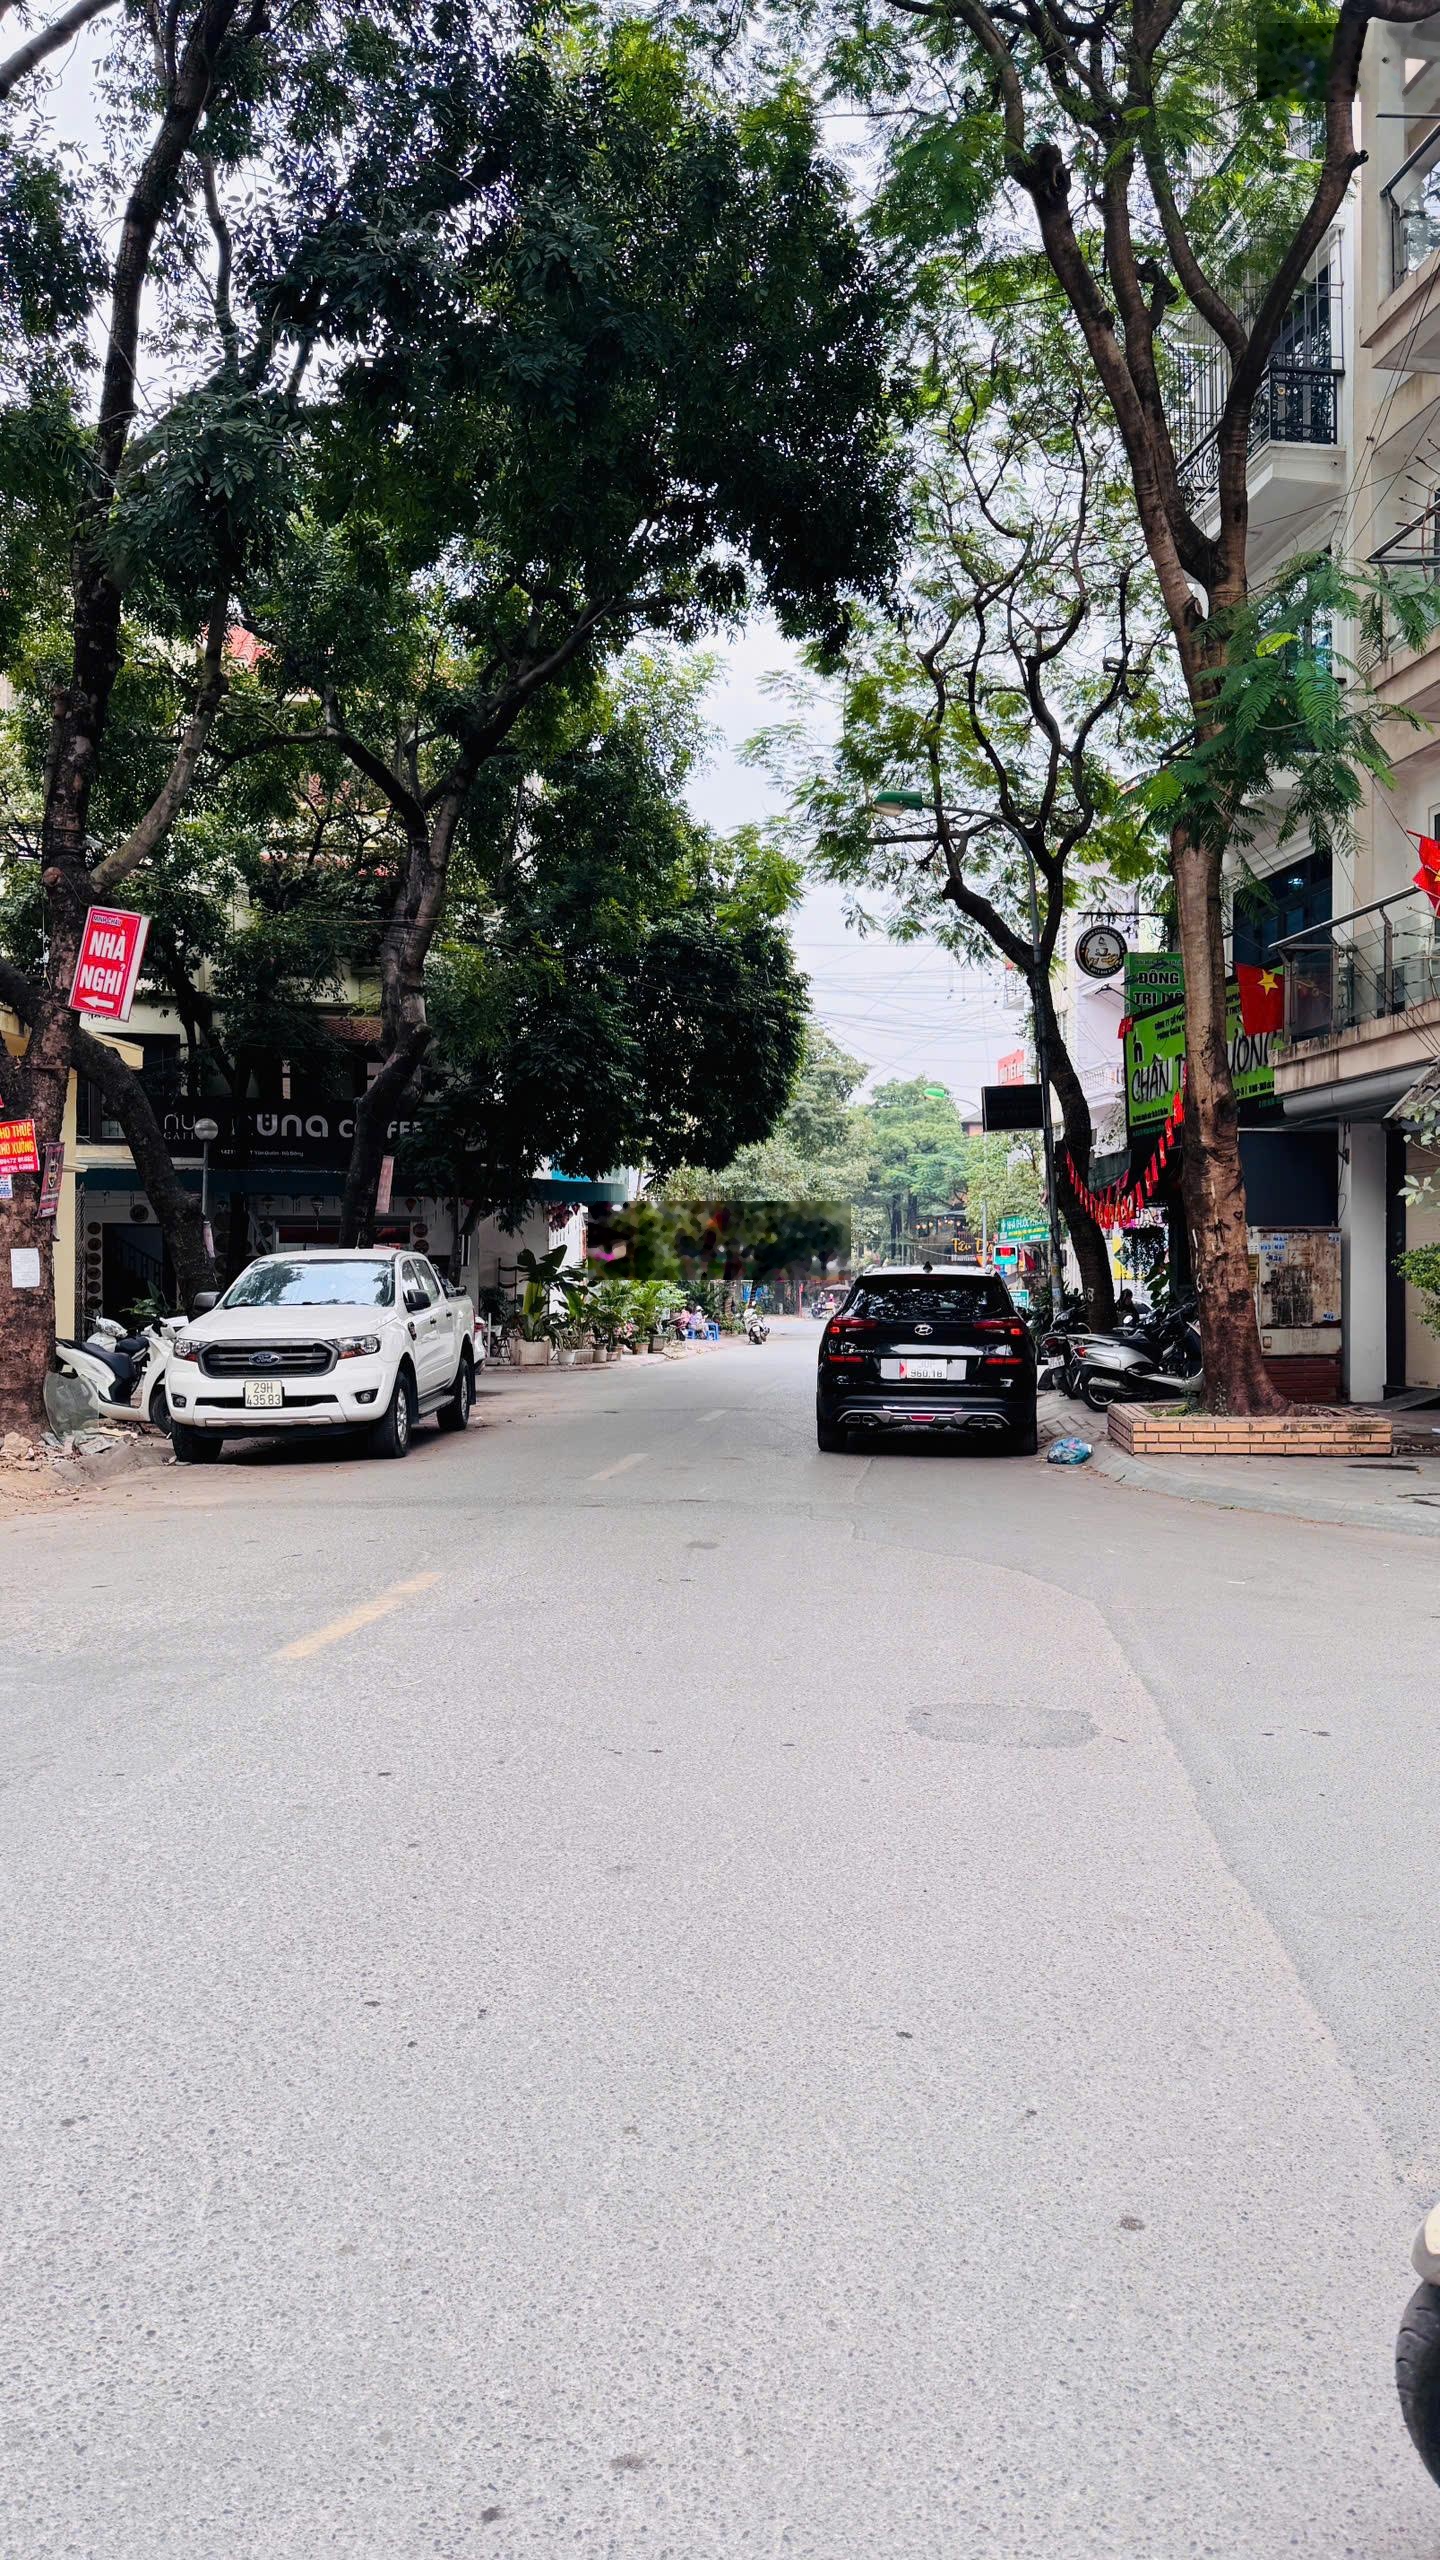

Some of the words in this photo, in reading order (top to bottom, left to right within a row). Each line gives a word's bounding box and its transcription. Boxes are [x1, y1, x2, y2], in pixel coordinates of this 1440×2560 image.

[88, 929, 127, 962] NHÀ
[79, 963, 126, 996] NGHỈ
[253, 1382, 273, 1394] 29H
